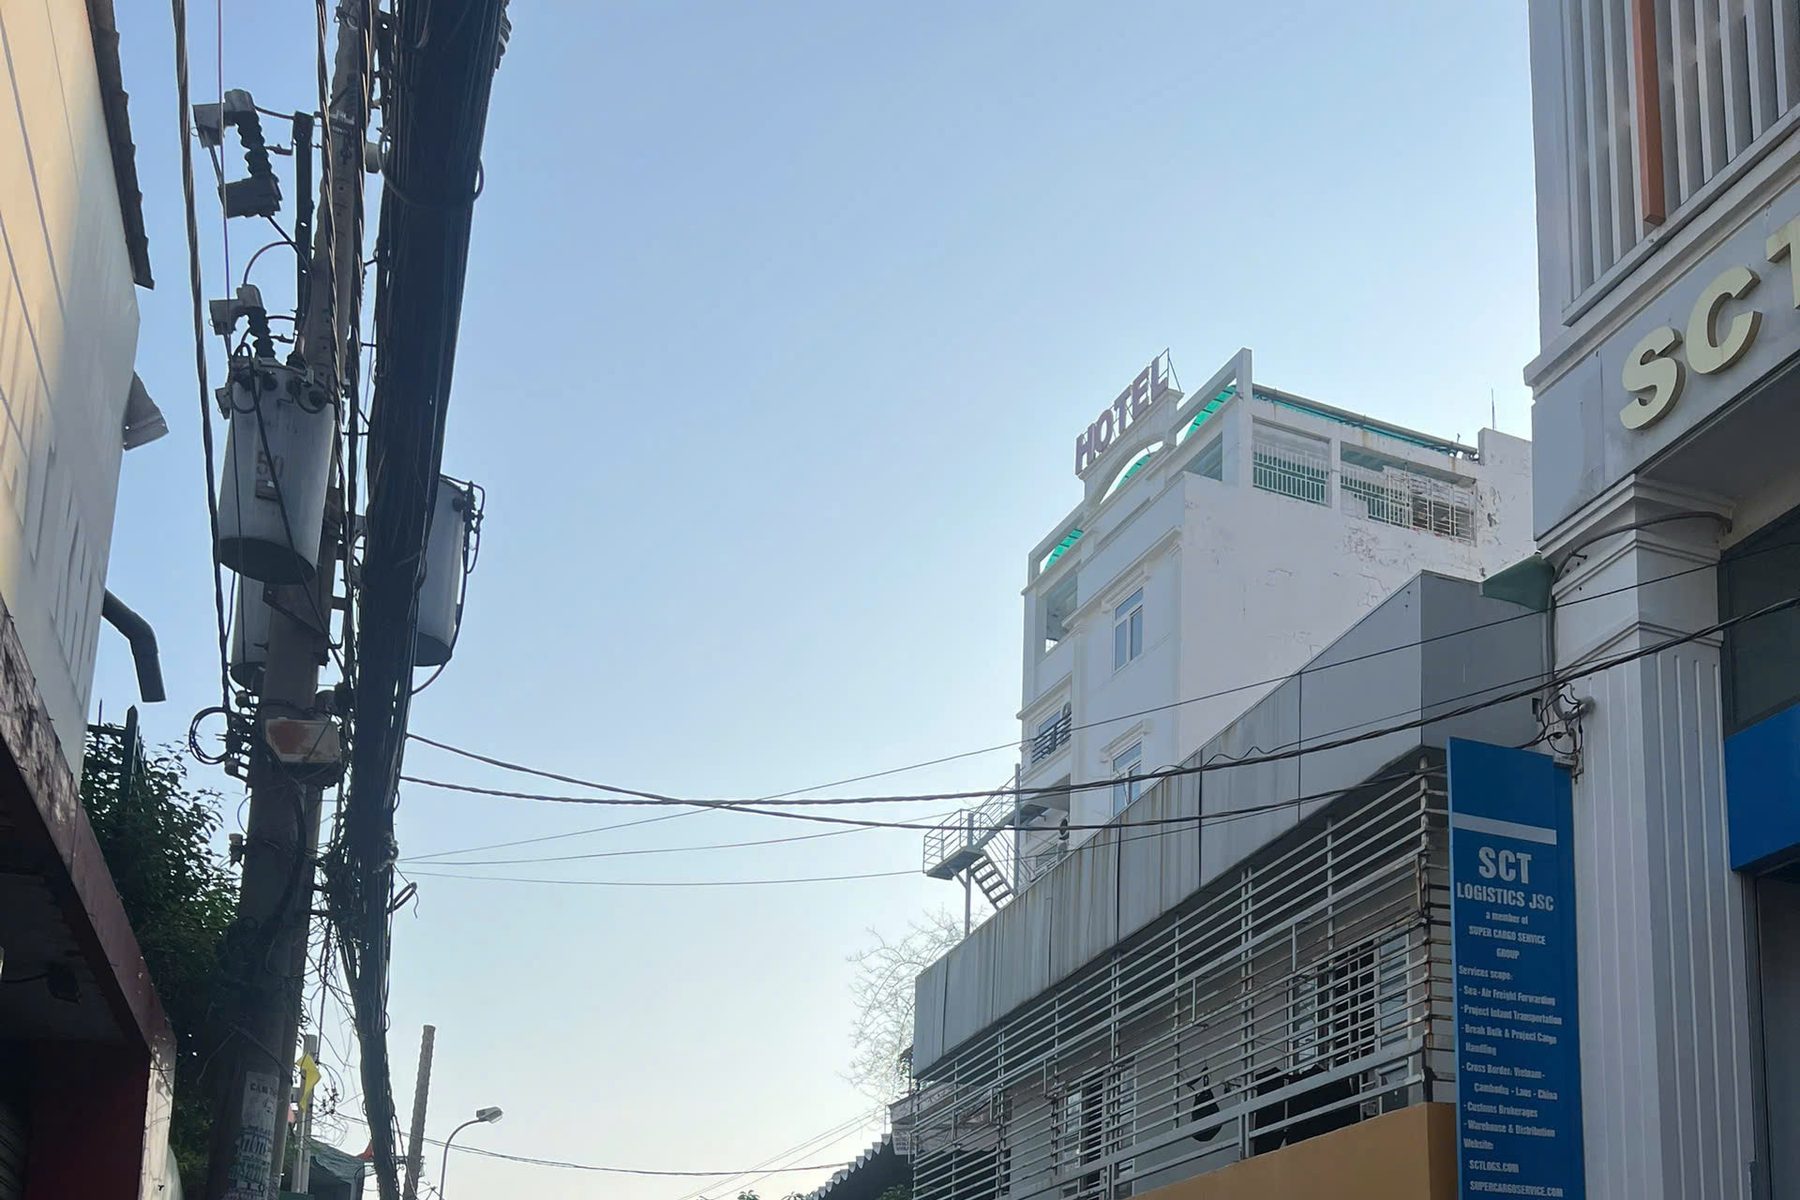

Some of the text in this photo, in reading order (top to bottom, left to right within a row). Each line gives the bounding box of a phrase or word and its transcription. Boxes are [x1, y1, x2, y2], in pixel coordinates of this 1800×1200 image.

[1075, 355, 1169, 475] HOTEL
[1478, 846, 1533, 885] SCT
[1456, 881, 1555, 912] LOGISTICS JSC
[1491, 911, 1521, 924] member
[1520, 915, 1529, 925] of
[1468, 924, 1547, 946] SUPER CARGO SERVICE
[1495, 947, 1520, 960] GROUP
[1458, 964, 1489, 978] Services
[1481, 986, 1492, 998] Air
[1492, 988, 1517, 1001] Freight
[1517, 991, 1556, 1007] Forwarding
[1490, 1007, 1513, 1020] Inland
[1513, 1010, 1563, 1026] Transportation
[1464, 1023, 1486, 1036] Break
[1486, 1026, 1504, 1038] Bulk
[1511, 1029, 1537, 1042] Project
[1537, 1032, 1558, 1045] Cargo
[1465, 1041, 1497, 1057] Handling
[1466, 1061, 1487, 1074] Cross
[1473, 1082, 1559, 1101] Cambodia Laos China
[1467, 1100, 1539, 1119] Customs Brokerages
[1467, 1119, 1507, 1133] Warehouse
[1515, 1124, 1556, 1138] Distribution
[1469, 1159, 1520, 1174] SCTLOGS.COM
[1469, 1180, 1564, 1199] SUPERCARGOSERVICE.COM
